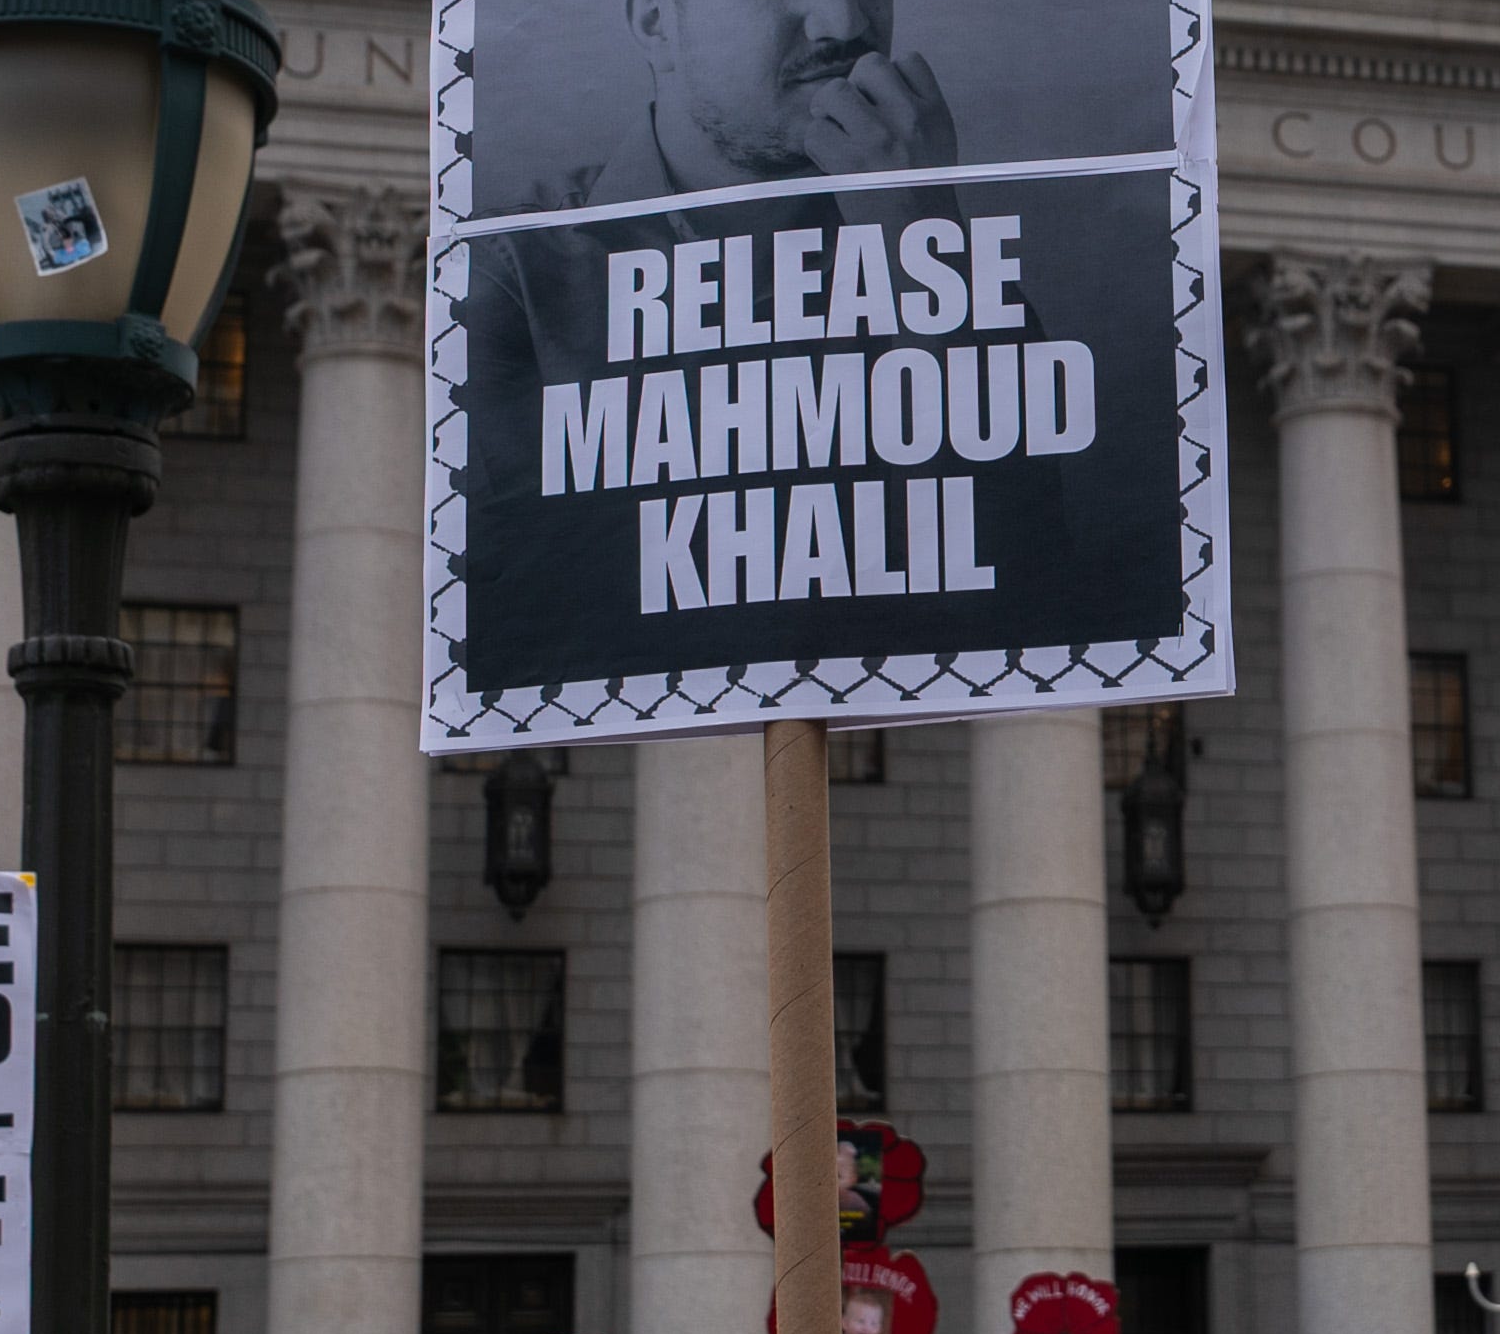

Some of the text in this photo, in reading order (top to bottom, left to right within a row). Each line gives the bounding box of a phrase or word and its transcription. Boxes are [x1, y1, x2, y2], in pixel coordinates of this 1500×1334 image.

[607, 214, 1025, 363] RELEASE
[540, 339, 1097, 496] MAHMOUD
[639, 476, 995, 614] KHALIL
[1029, 1281, 1063, 1302] WILL
